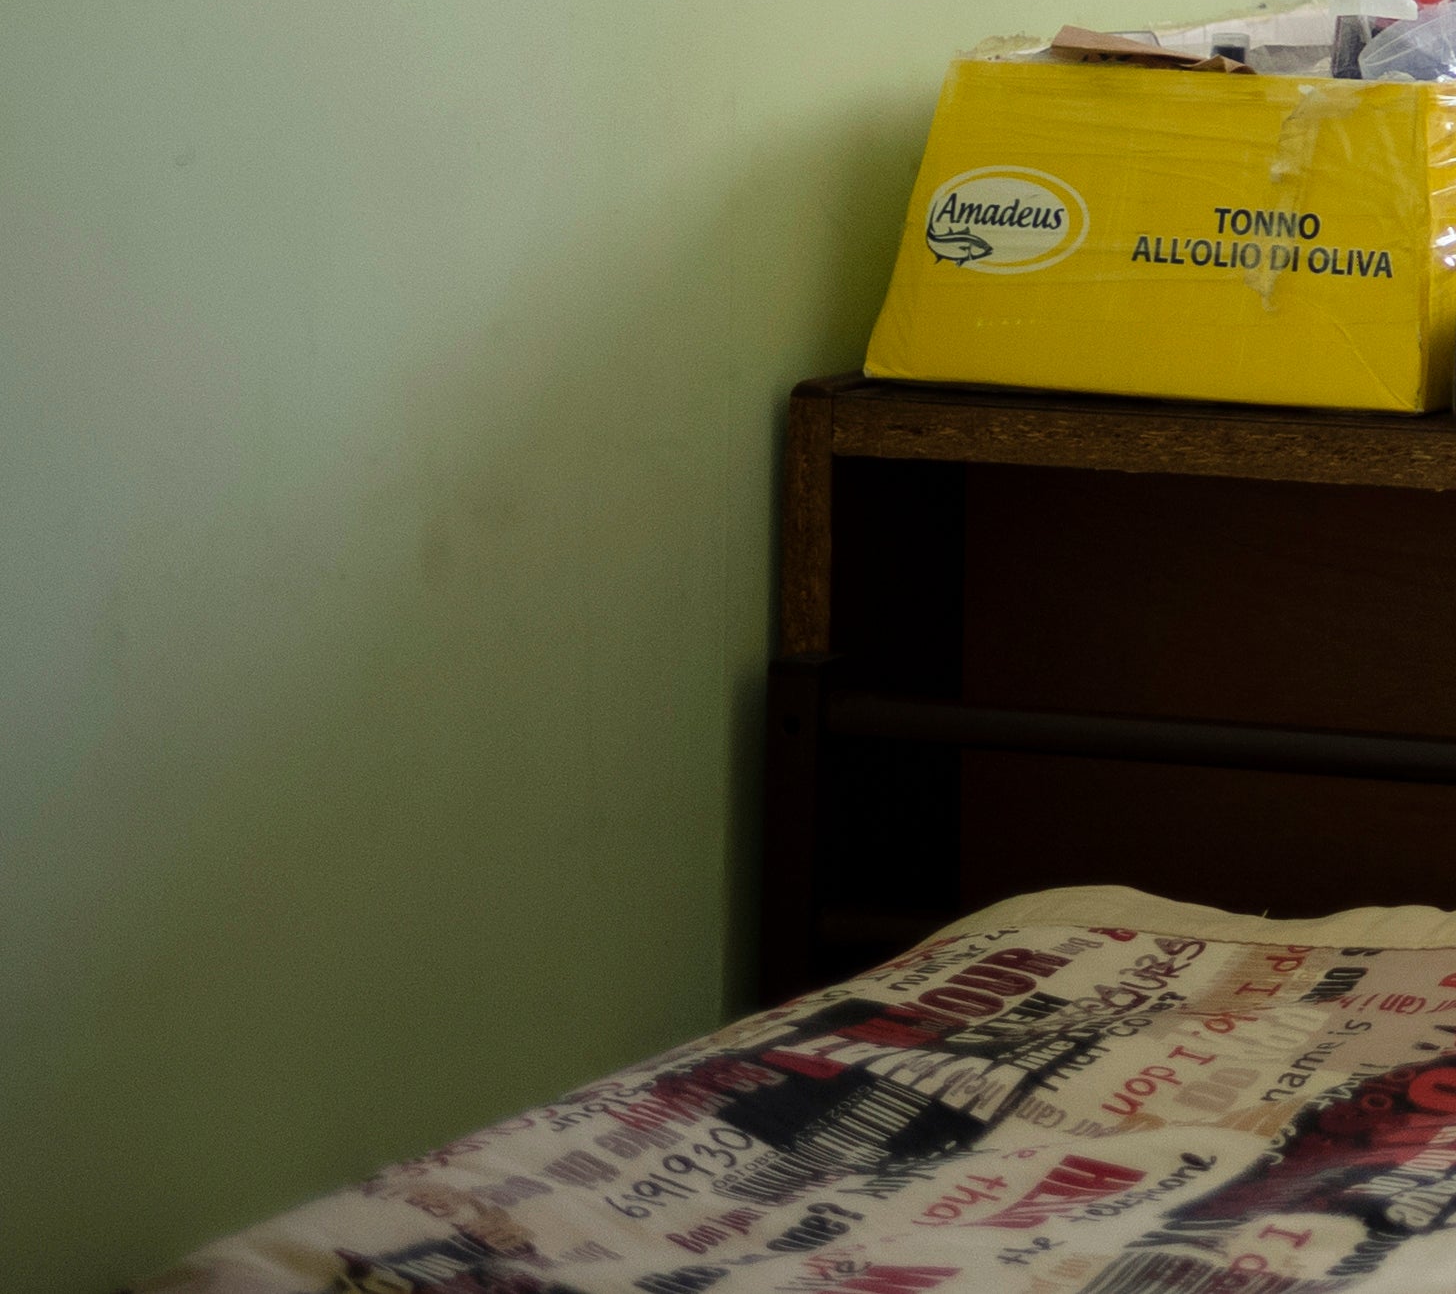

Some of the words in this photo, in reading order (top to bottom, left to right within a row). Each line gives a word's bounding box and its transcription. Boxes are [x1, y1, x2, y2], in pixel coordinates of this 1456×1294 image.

[936, 192, 1065, 230] Amadeus
[1214, 207, 1320, 240] TONNO
[1131, 235, 1261, 270] ALL'OLIO
[1269, 244, 1299, 271] DI
[1307, 247, 1393, 279] OLIVA
[1263, 1038, 1343, 1104] name
[1332, 1018, 1374, 1038] is
